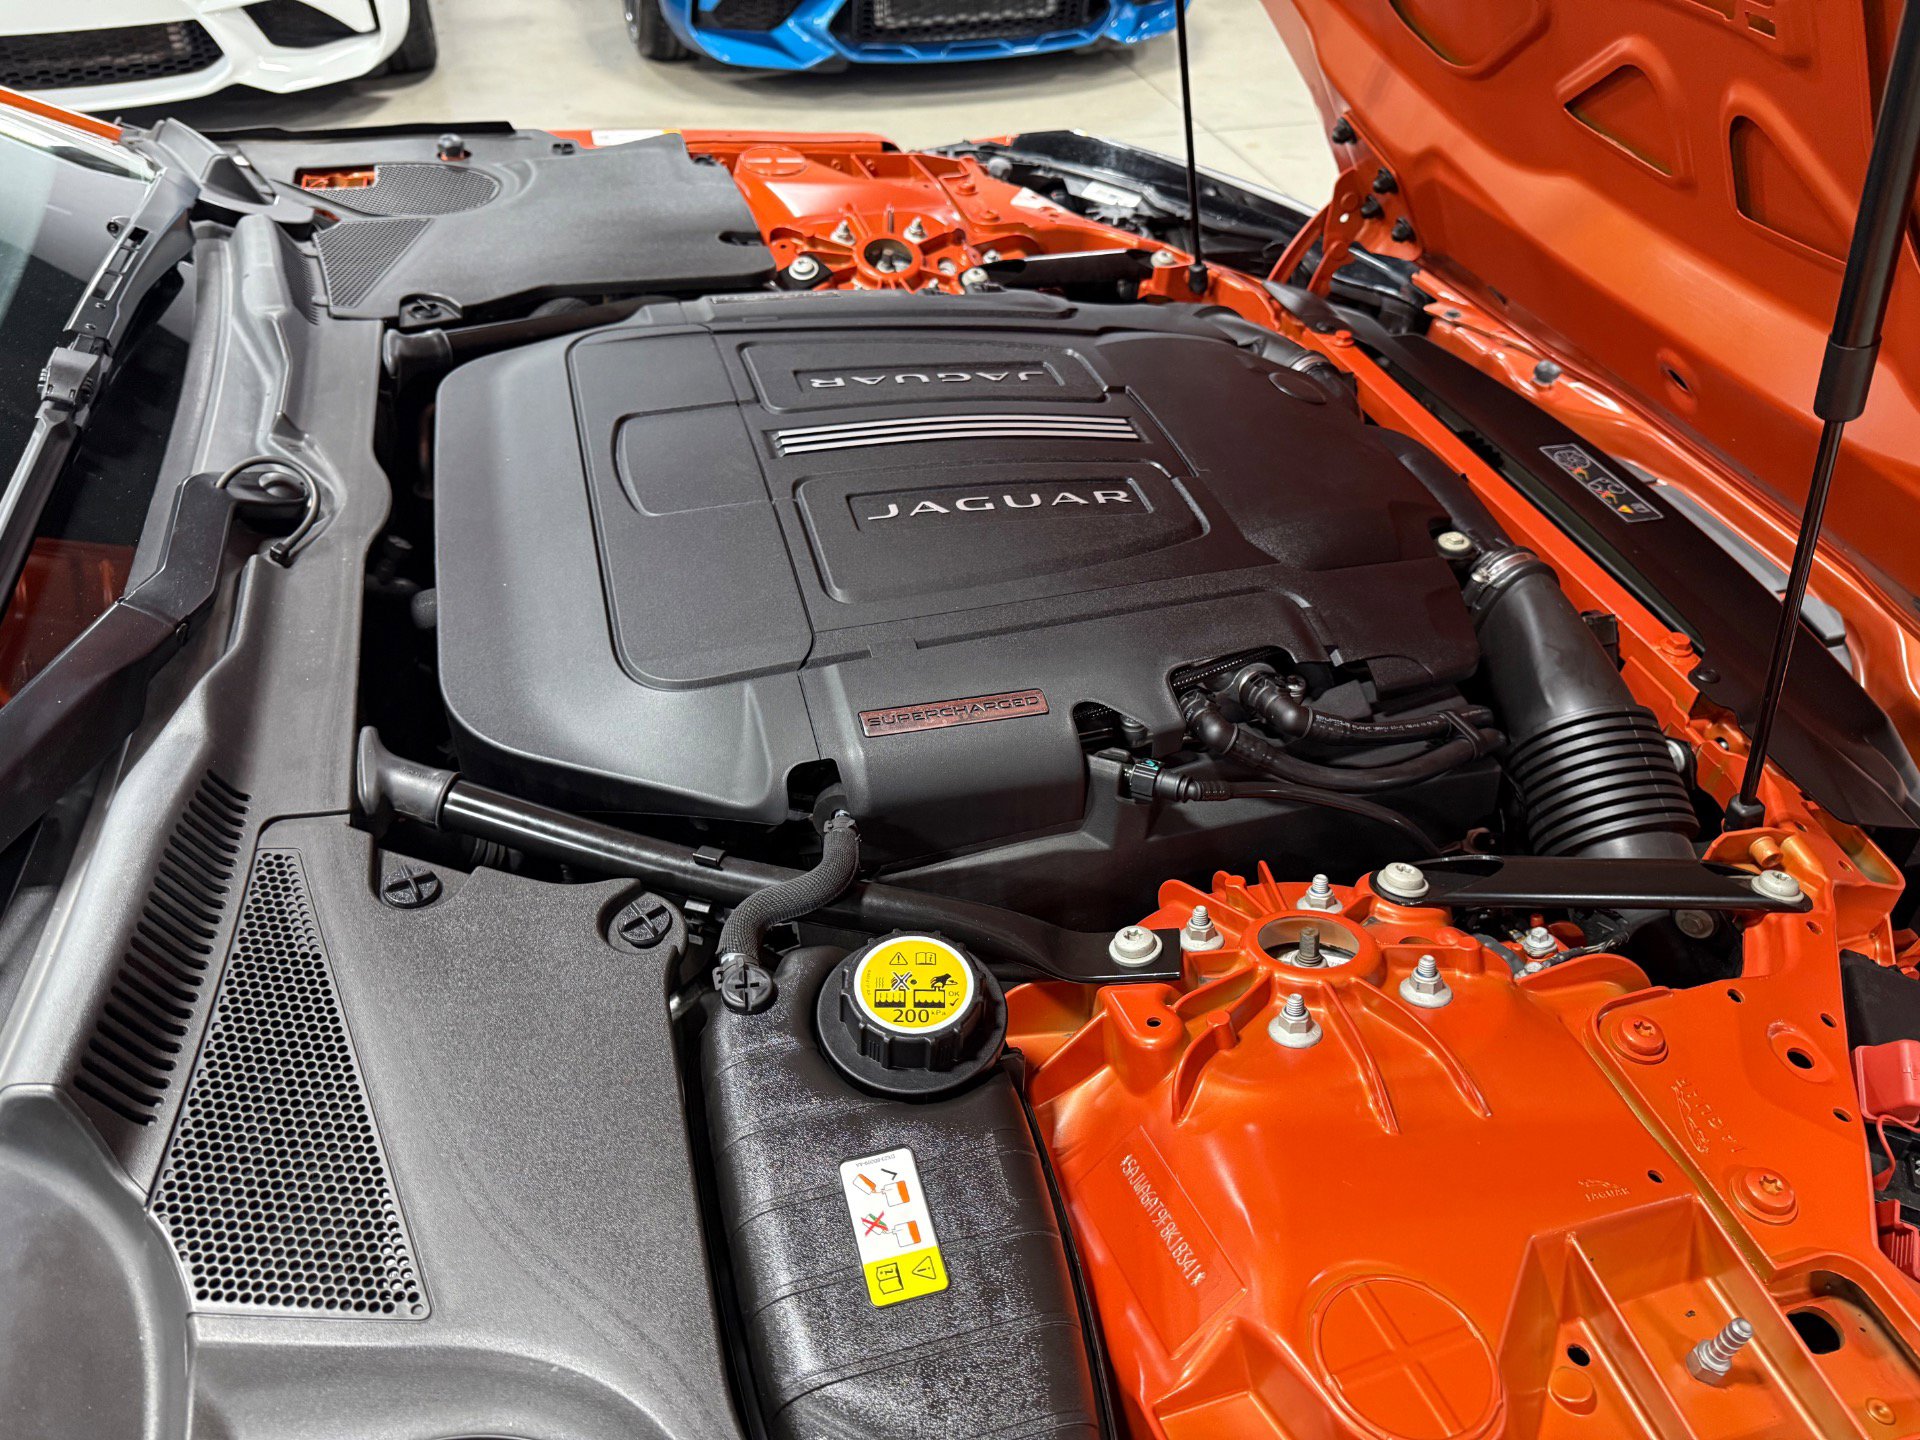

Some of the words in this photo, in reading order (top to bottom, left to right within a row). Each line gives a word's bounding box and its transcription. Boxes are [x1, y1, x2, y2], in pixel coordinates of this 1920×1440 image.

[810, 370, 1045, 389] JAGUAR
[867, 489, 1134, 521] JAGUAR
[867, 695, 1041, 727] SUPERCHARGED
[892, 1008, 930, 1023] 200
